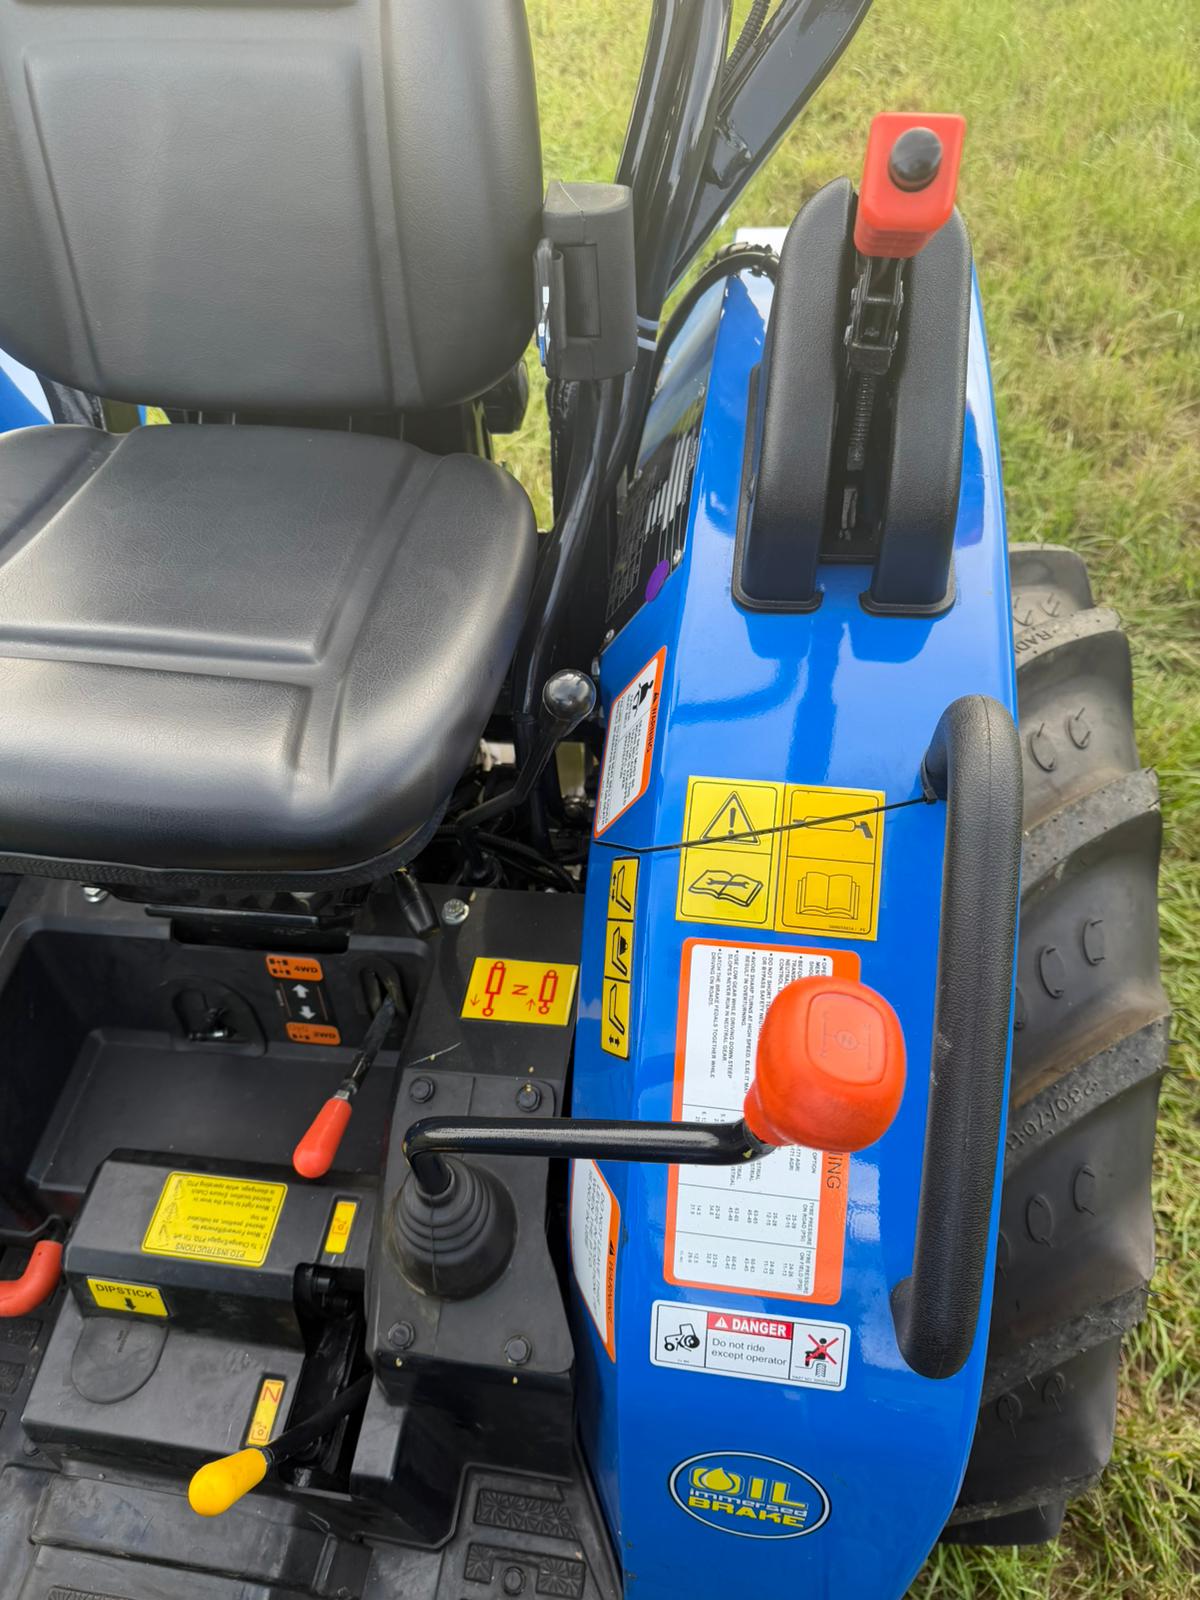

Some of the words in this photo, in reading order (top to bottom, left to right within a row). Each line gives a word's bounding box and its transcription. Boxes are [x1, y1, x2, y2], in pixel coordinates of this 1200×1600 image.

[827, 1152, 843, 1189] ING
[175, 1243, 229, 1256] INSTRUCTIONS
[230, 1248, 246, 1258] PTO
[95, 1284, 155, 1298] DIPSTICK
[732, 1318, 787, 1337] DANGER
[712, 1338, 726, 1347] Do
[728, 1340, 744, 1350] not
[747, 1343, 765, 1352] ride
[711, 1351, 744, 1361] except
[746, 1354, 787, 1366] operator
[262, 1386, 281, 1403] N
[690, 1467, 808, 1508] OIL
[690, 1488, 807, 1517] immersed
[688, 1496, 806, 1528] BRAKE
